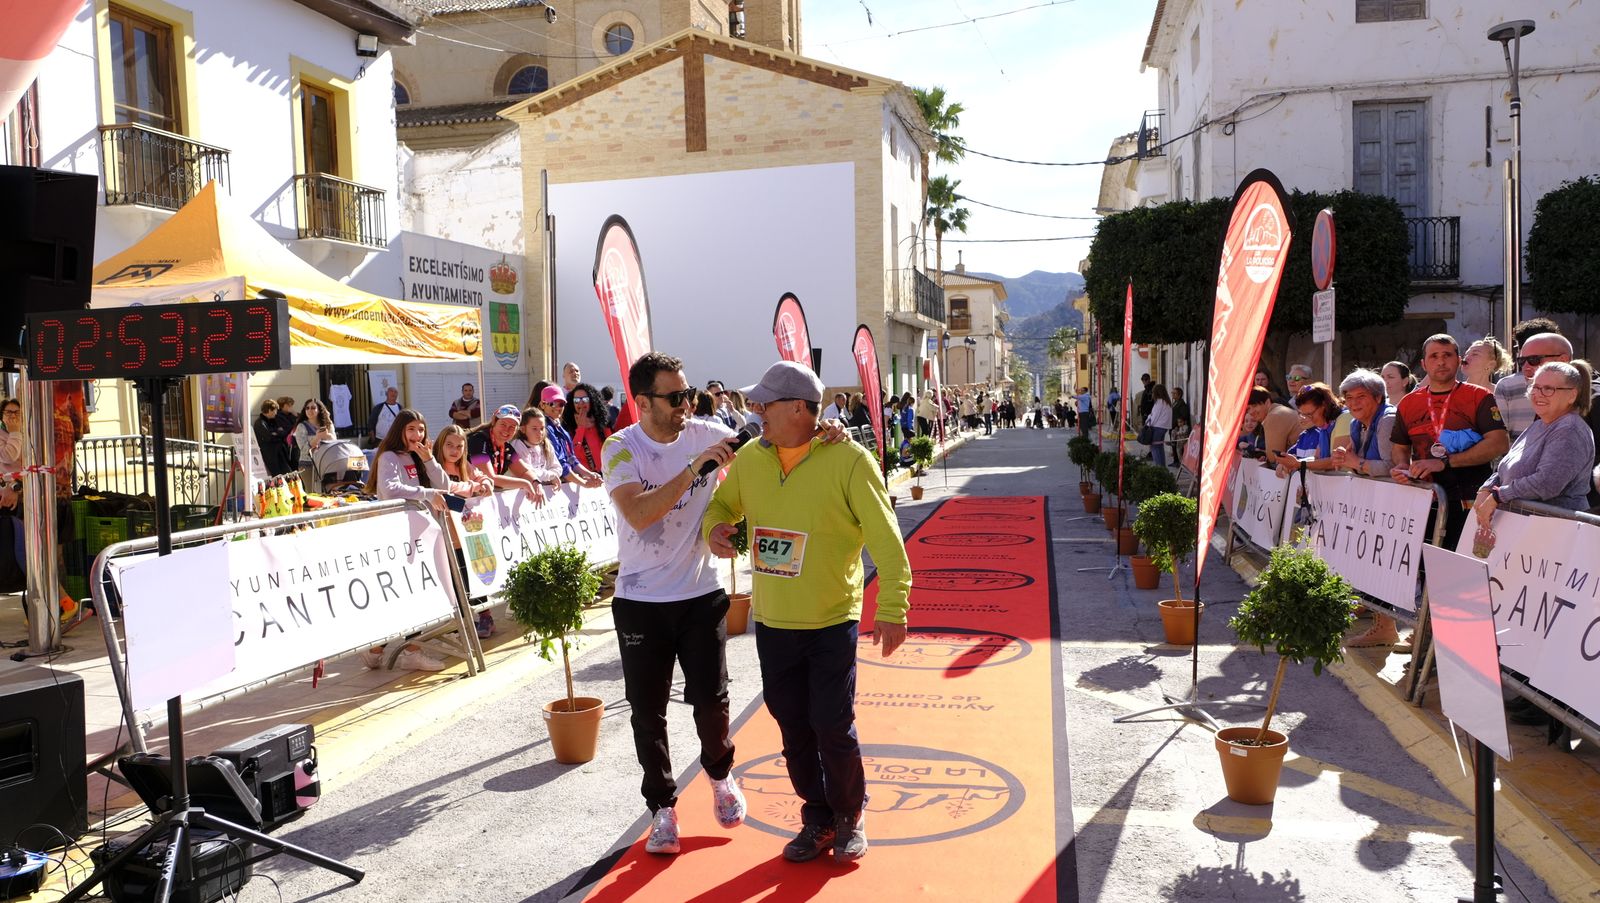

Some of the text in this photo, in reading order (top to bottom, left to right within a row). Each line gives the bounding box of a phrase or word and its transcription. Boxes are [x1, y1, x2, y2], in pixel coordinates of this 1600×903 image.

[409, 256, 484, 283] EXCELENTÍSIMO
[411, 283, 483, 306] AYUNTAMIENTO
[36, 306, 273, 373] 02:53:23
[501, 515, 614, 562] CANTORIA
[1400, 518, 1415, 535] DE
[758, 538, 793, 556] 647
[1309, 519, 1411, 576] ANTORIA
[230, 538, 425, 597] YUNTAMIENTO DE
[854, 692, 944, 702] Cantori
[854, 700, 995, 712] Ayuntamie
[945, 767, 987, 778] LA
[160, 842, 177, 881] VONYX
